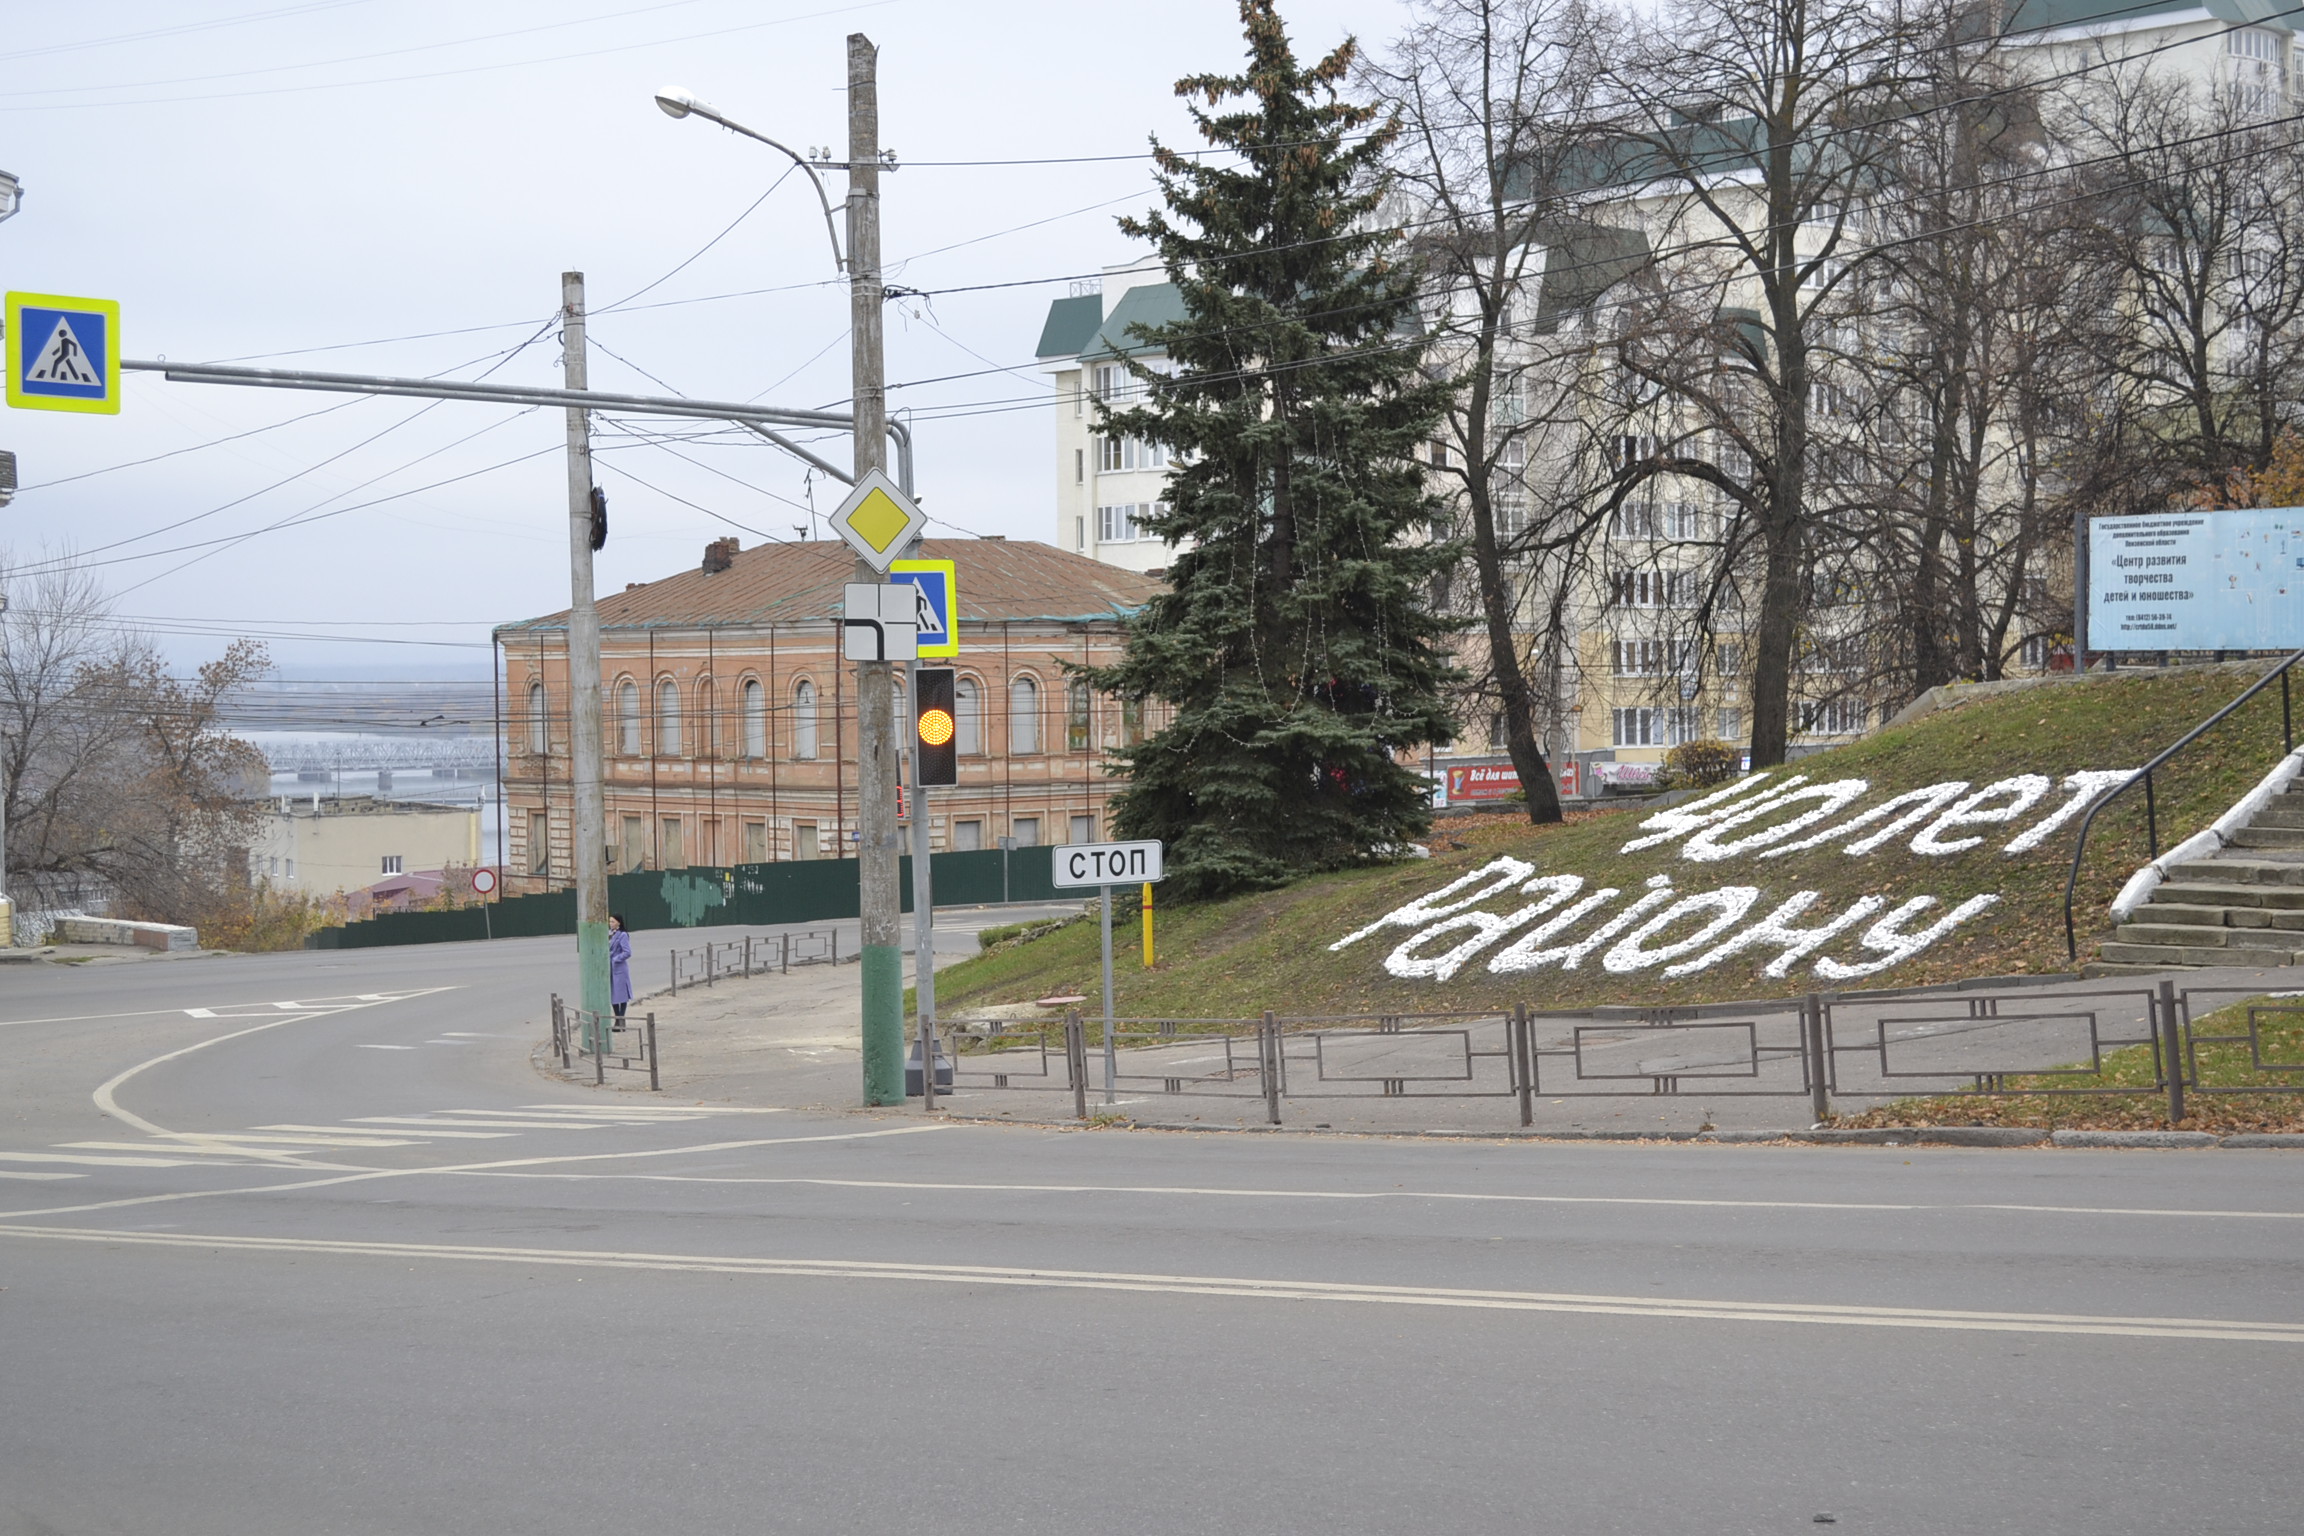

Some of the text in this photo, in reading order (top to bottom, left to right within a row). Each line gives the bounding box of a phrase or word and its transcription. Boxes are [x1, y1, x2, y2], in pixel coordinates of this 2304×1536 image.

[2099, 522, 2141, 530] Государственное
[2111, 555, 2186, 569] «Центр развития
[2124, 573, 2173, 586] творчества
[2103, 590, 2194, 604] детей и юношества»
[1470, 768, 1486, 781] Всё
[1486, 767, 1500, 781] для
[1757, 769, 2144, 857] лет
[1069, 849, 1146, 879] СТОП
